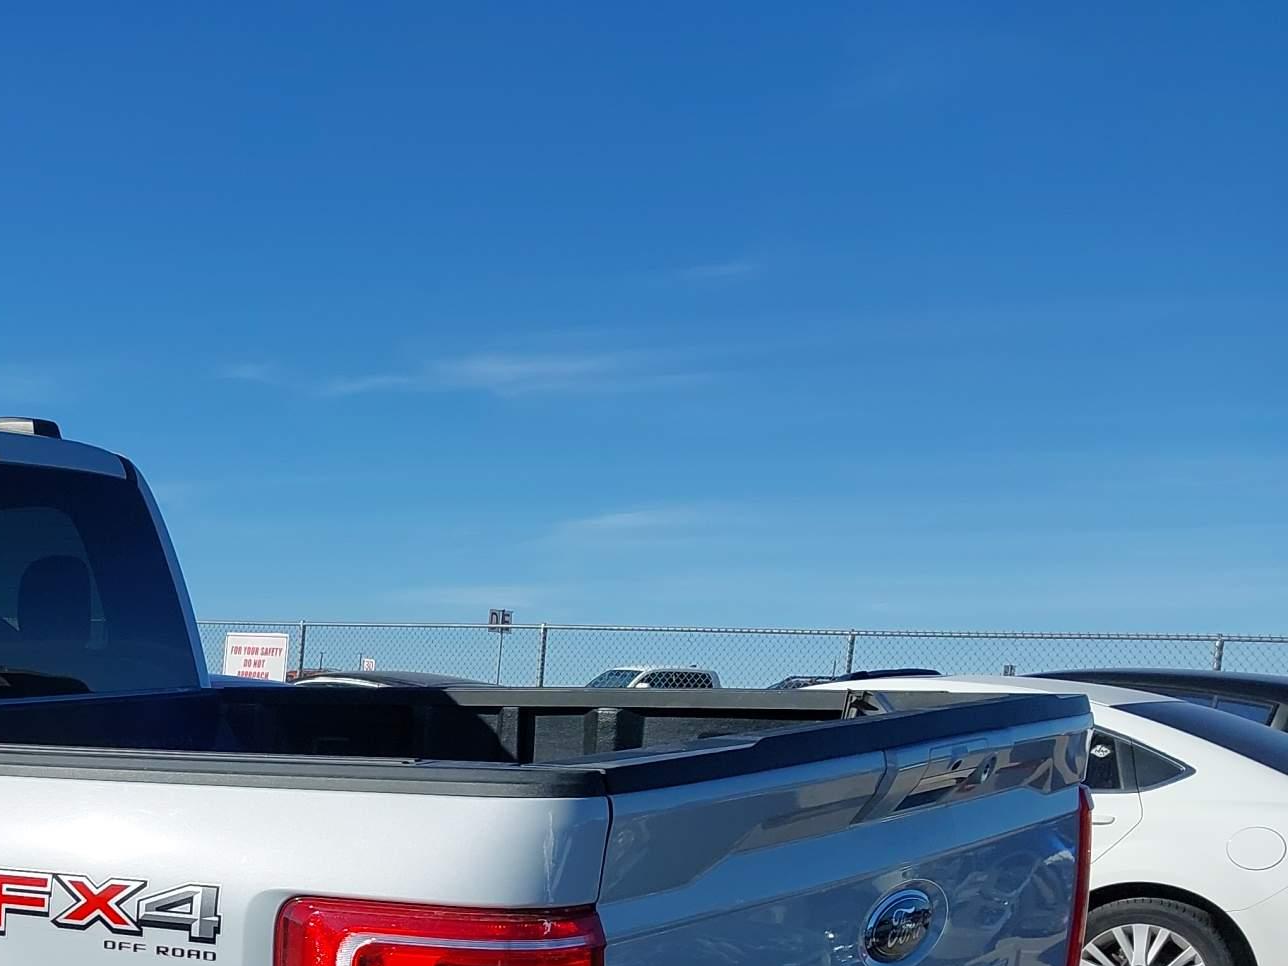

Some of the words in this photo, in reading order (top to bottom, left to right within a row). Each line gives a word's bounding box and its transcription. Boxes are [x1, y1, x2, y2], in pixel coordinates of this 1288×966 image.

[231, 646, 243, 655] FOR
[244, 646, 260, 655] YOUR
[260, 647, 283, 656] SAFETY
[243, 659, 252, 668] DO
[253, 660, 266, 668] NOT
[103, 940, 147, 952] OFF
[155, 946, 217, 961] ROAD
